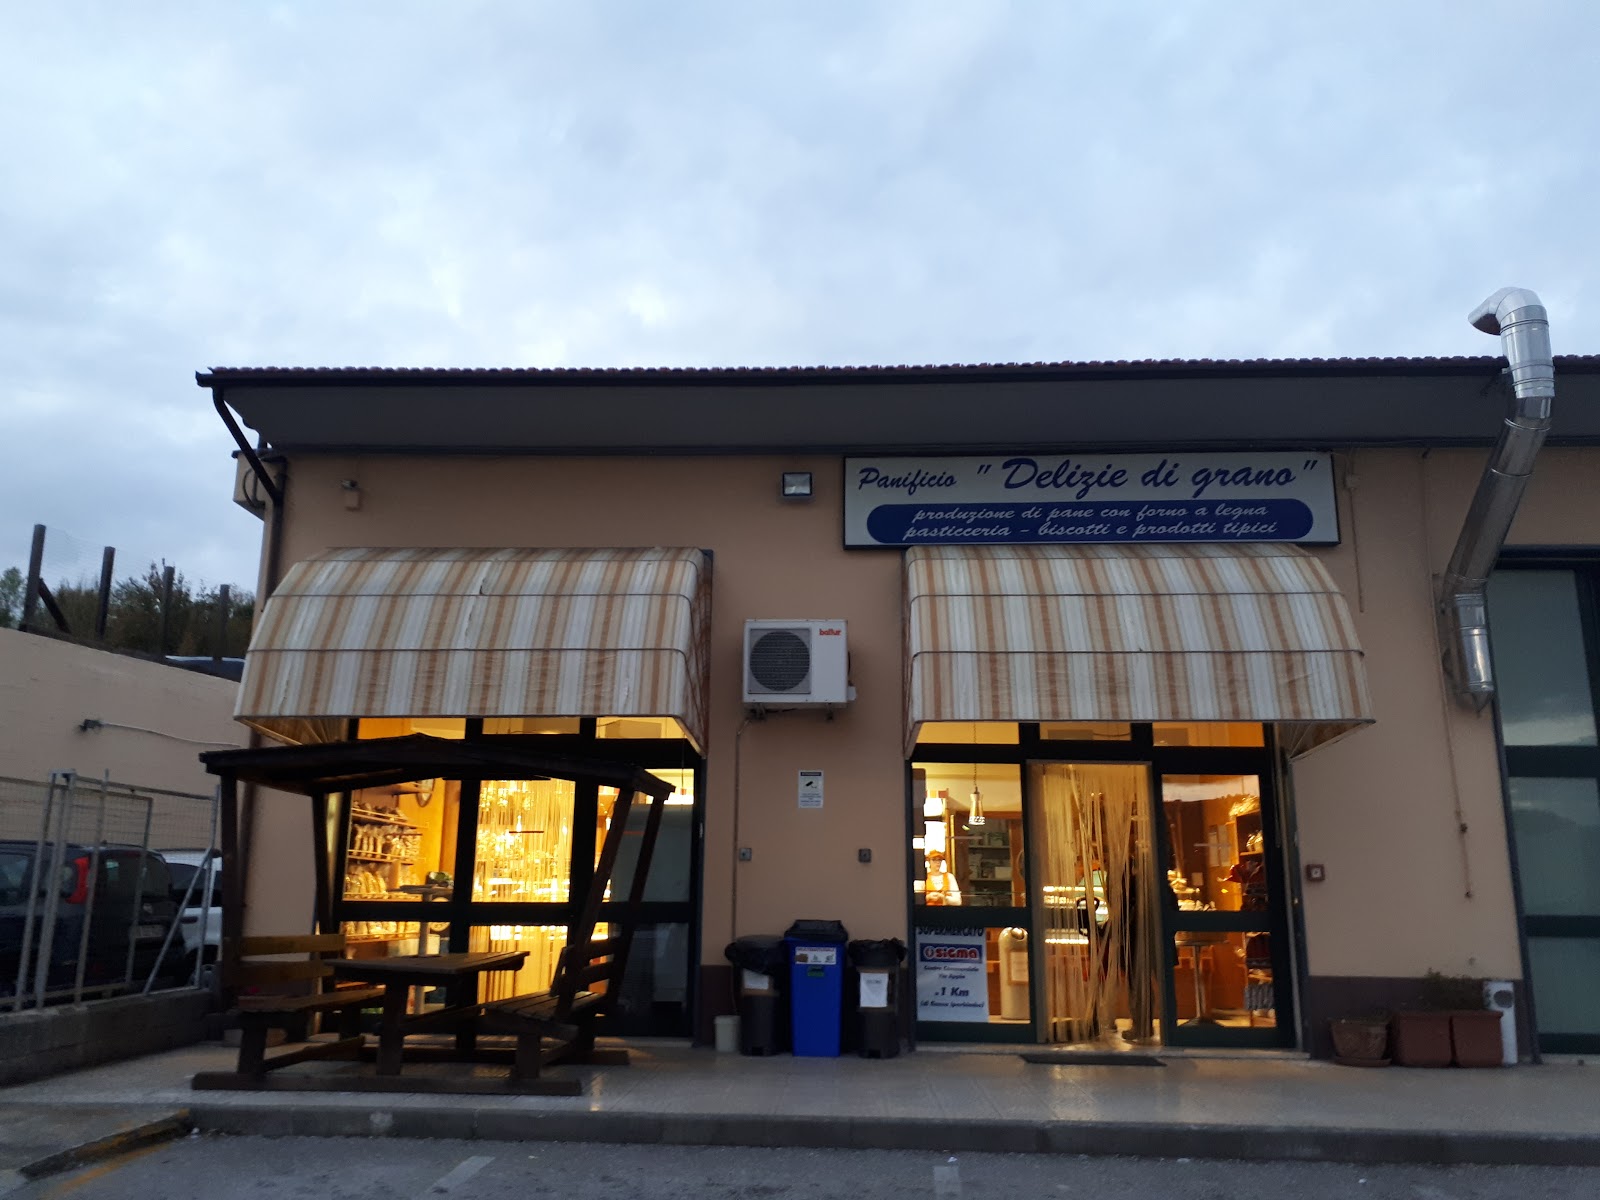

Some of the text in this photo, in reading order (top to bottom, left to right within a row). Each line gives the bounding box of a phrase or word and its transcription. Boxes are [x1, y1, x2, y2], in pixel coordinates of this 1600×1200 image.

[858, 467, 957, 496] Panificio
[1141, 459, 1180, 488] di
[911, 503, 1269, 524] produzione di pane con forno a legna
[902, 525, 1012, 542] pasticceria
[1037, 521, 1111, 536] biscotti
[1116, 525, 1128, 535] e
[1132, 521, 1217, 539] prodotti
[1222, 520, 1278, 538] tipici
